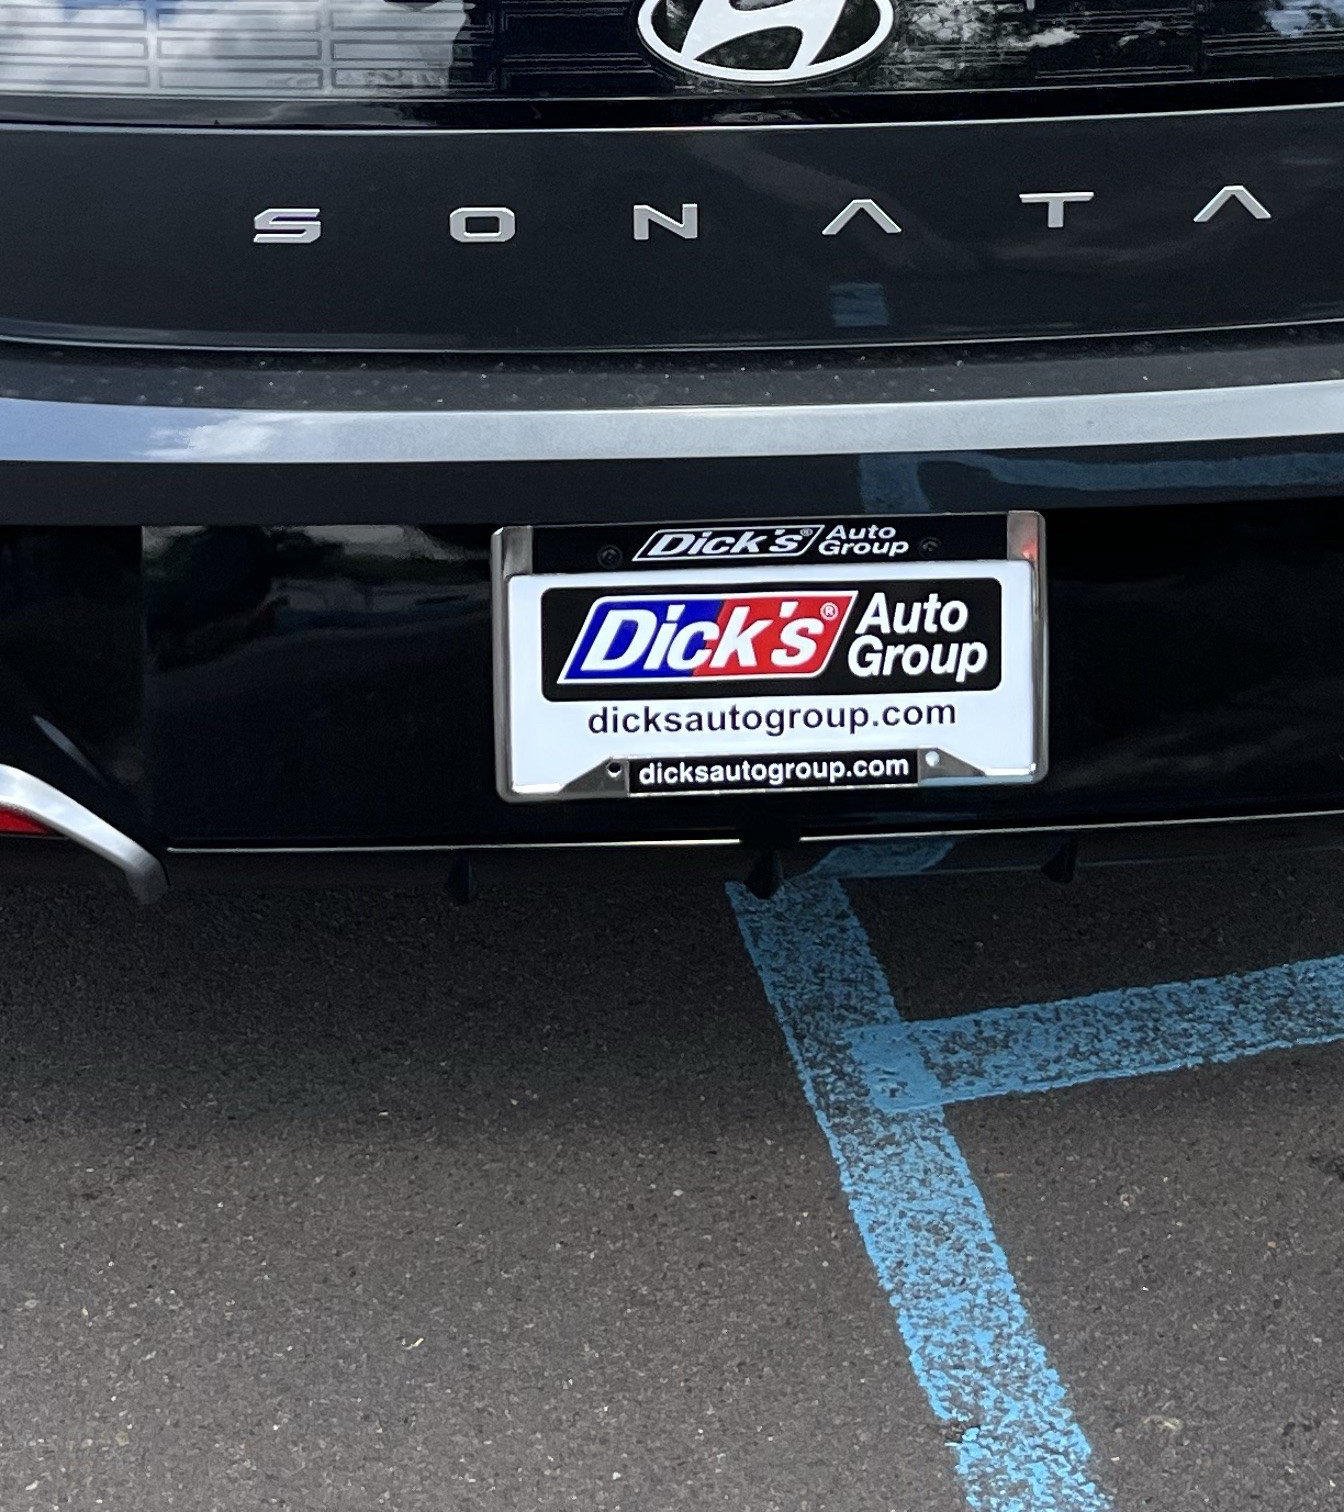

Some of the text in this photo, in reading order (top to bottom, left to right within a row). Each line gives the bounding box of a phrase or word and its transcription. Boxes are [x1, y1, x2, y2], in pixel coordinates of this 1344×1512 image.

[253, 185, 1272, 243] SONATA
[818, 539, 909, 557] Group
[825, 524, 896, 540] Auto
[855, 591, 968, 635] Auto
[847, 632, 988, 683] Group
[587, 703, 957, 737] dicksautogroup.com
[638, 756, 910, 786] dicksautogroup.com
